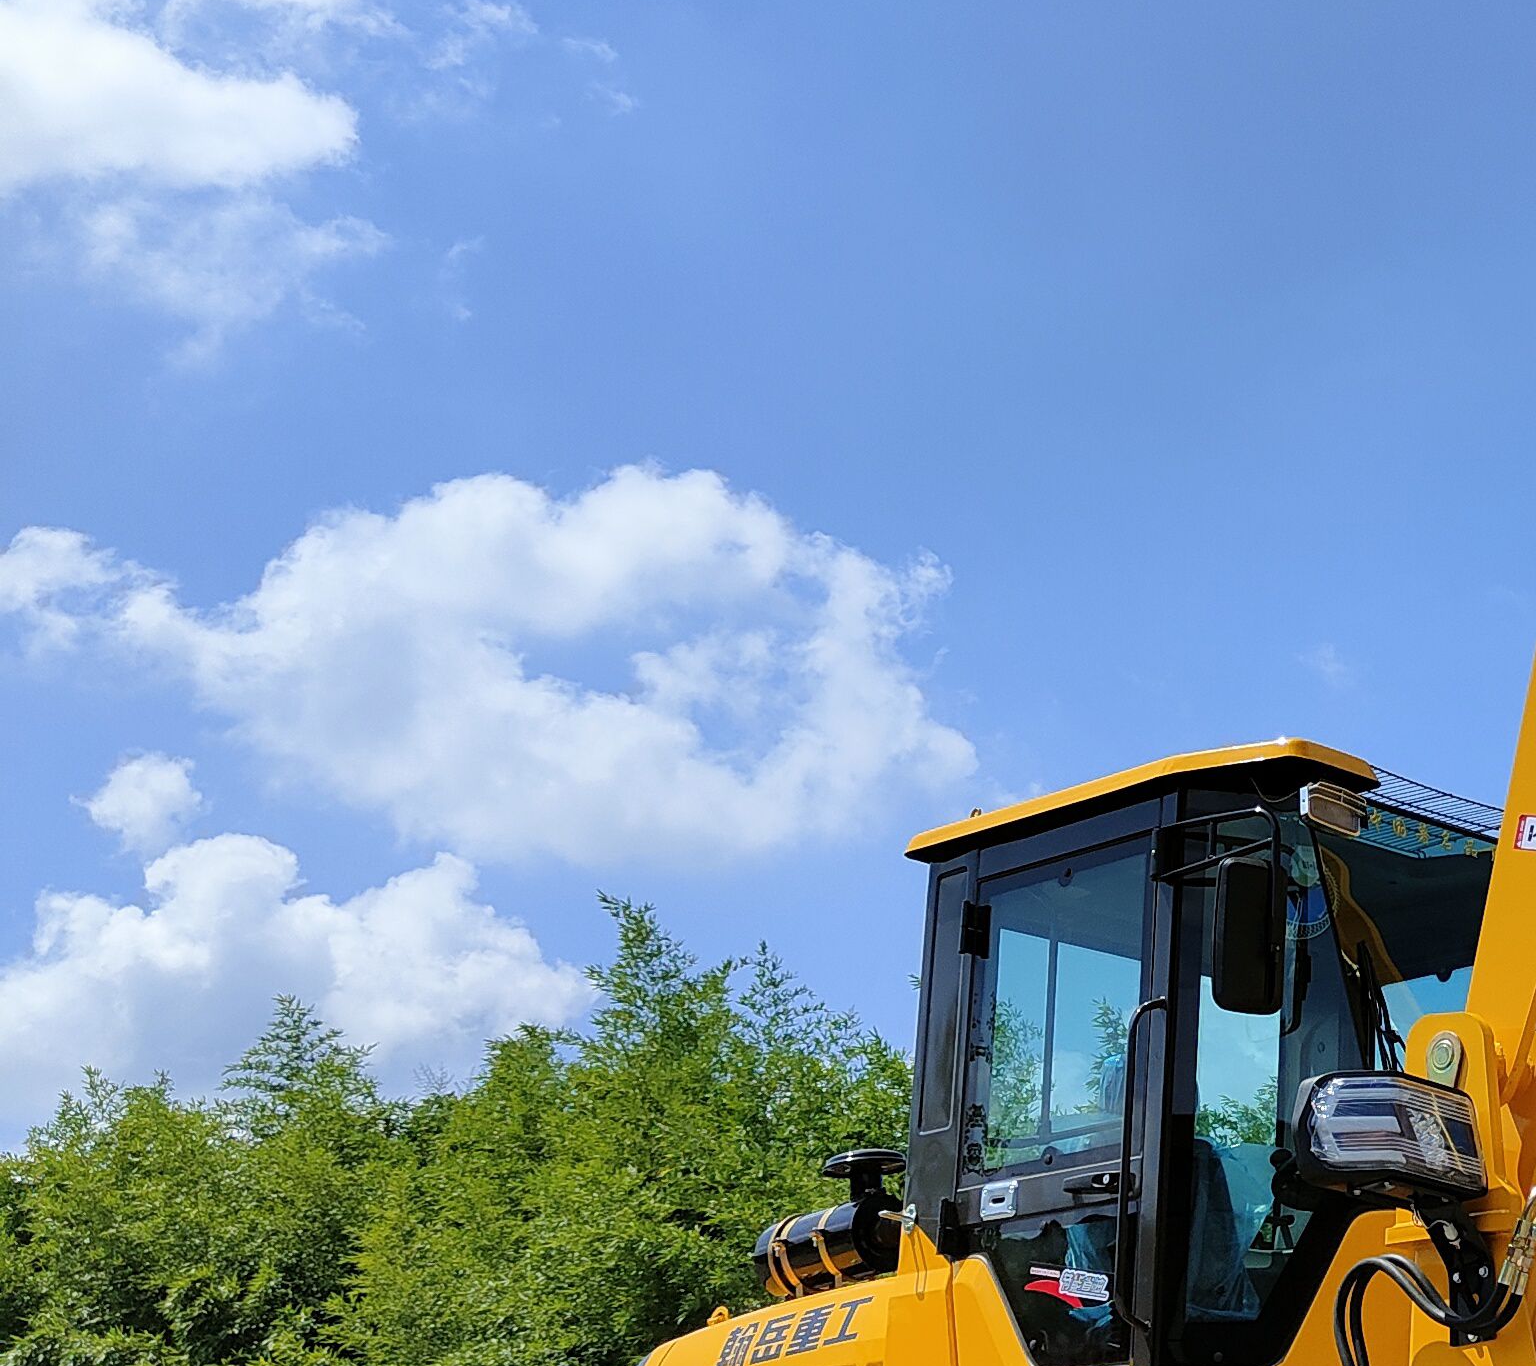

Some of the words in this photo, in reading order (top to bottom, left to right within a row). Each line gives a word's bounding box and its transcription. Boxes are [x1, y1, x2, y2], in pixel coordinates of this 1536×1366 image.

[1369, 807, 1496, 861] 中国著名品
